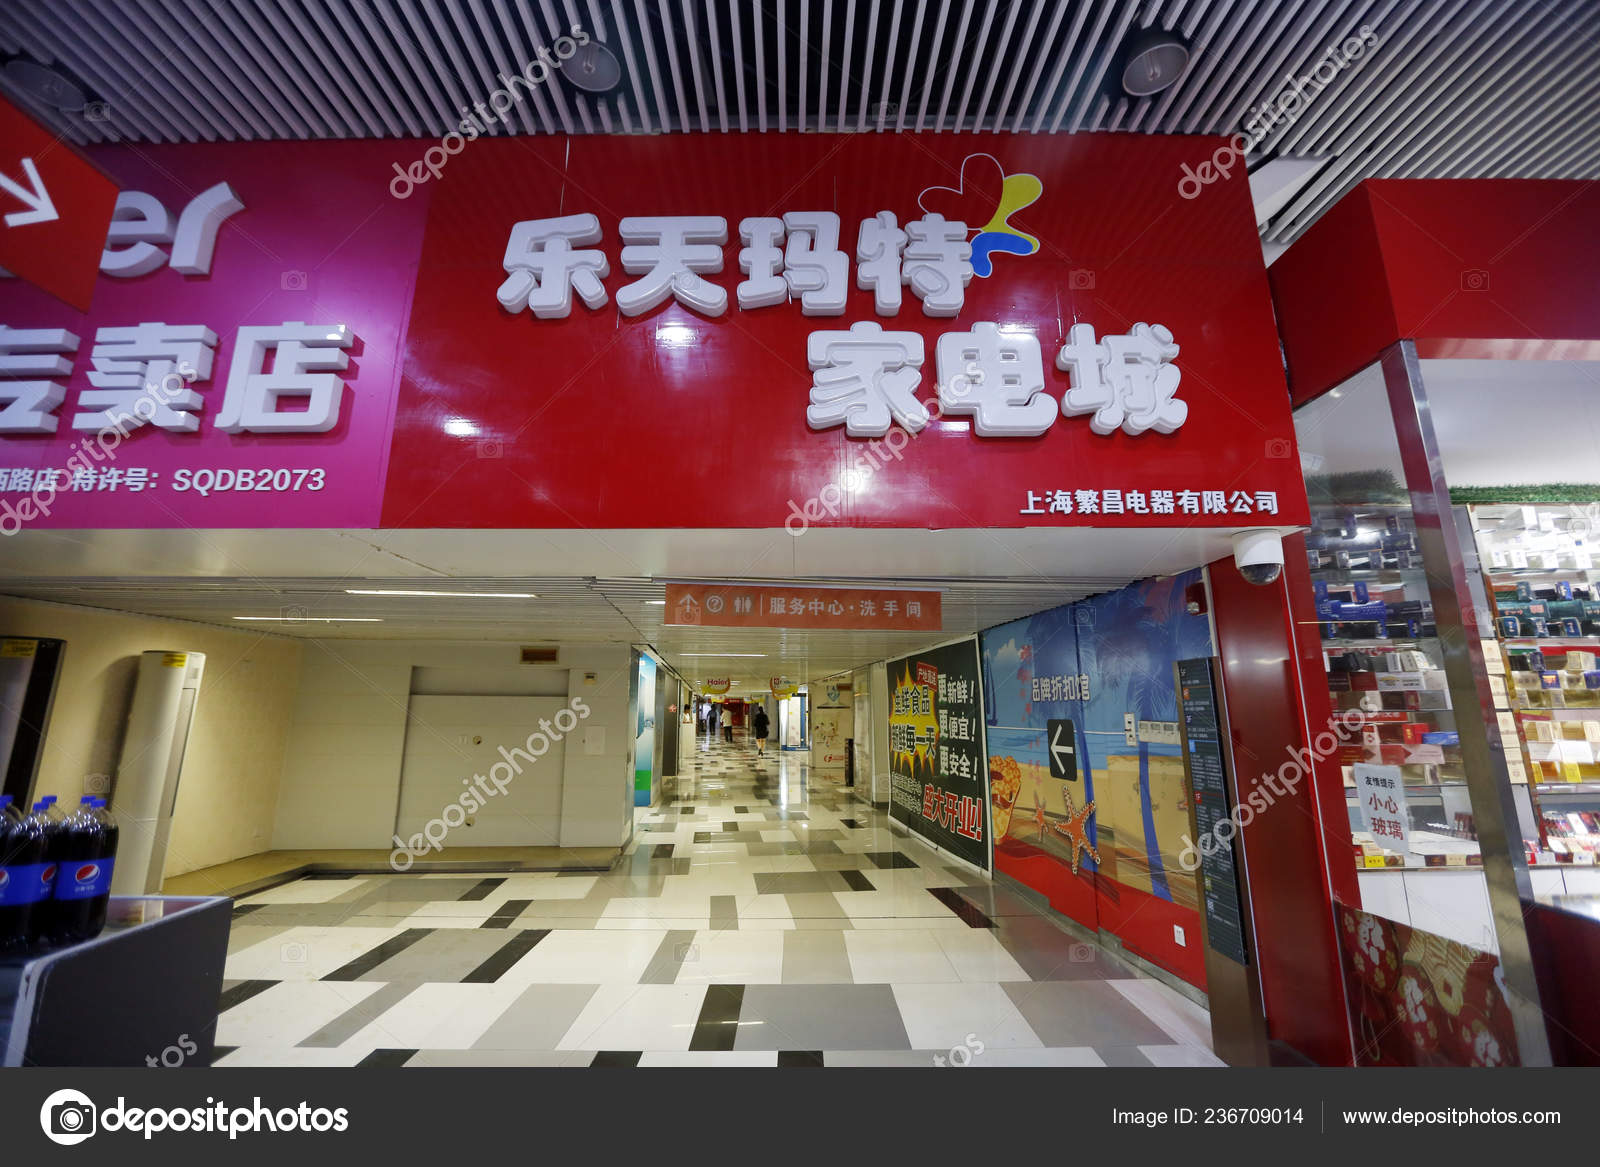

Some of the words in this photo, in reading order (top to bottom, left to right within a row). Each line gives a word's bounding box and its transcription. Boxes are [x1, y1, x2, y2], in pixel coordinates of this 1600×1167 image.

[99, 181, 246, 278] er
[497, 210, 974, 319] 乐天玛特
[807, 321, 1188, 437] 家电城
[172, 468, 326, 496] SQDB2073
[1020, 489, 1280, 516] 上海繁昌电器有限公司
[1032, 673, 1091, 702] 品牌折扣馆
[1365, 775, 1396, 789] 友情提示
[1368, 792, 1399, 814] 小心
[1371, 817, 1404, 841] 玻璃
